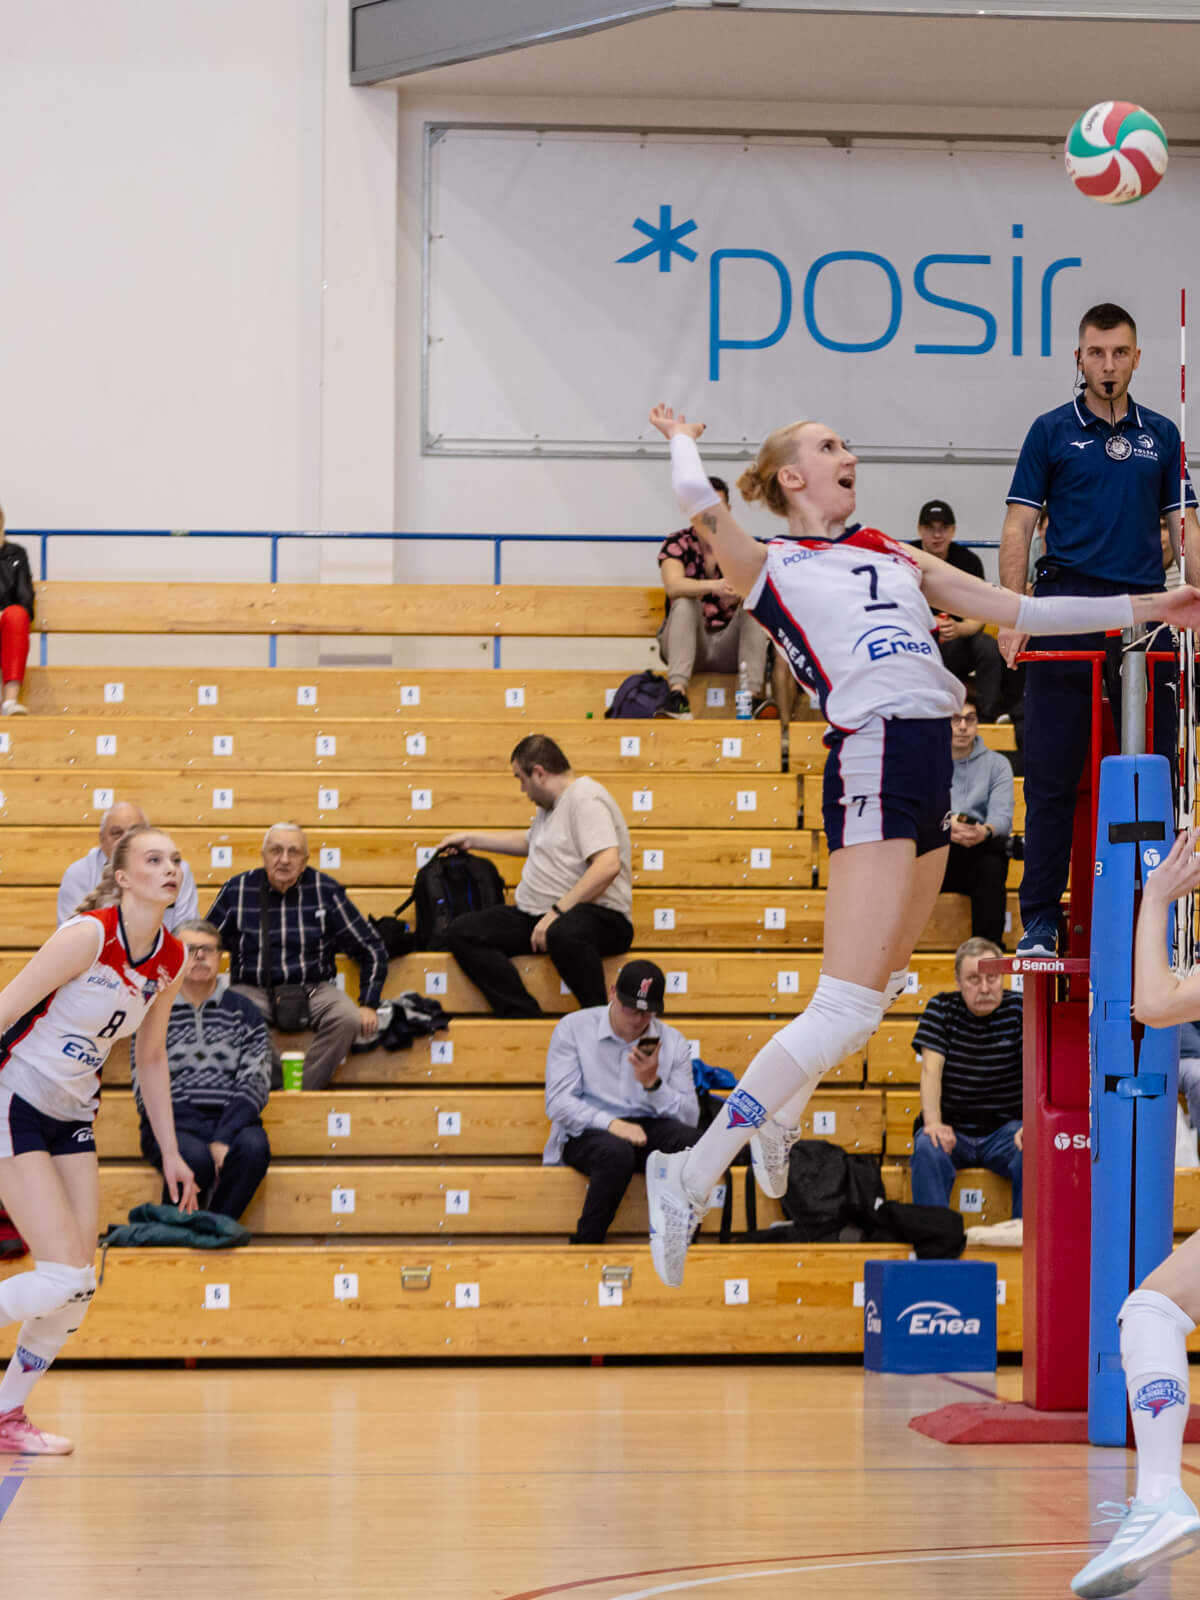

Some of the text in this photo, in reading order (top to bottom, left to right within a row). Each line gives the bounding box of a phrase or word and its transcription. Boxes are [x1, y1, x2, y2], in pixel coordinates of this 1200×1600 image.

[708, 223, 1083, 382] posir
[352, 439, 379, 482] B
[850, 564, 878, 601] 7
[866, 637, 932, 661] Enea
[204, 688, 211, 699] 6
[304, 689, 310, 699] 5
[407, 688, 413, 698] 4
[512, 691, 518, 701] 3
[323, 739, 329, 749] 5
[413, 738, 419, 748] 4
[627, 739, 633, 749] 2
[729, 741, 734, 751] 1
[101, 792, 107, 801] 7
[219, 791, 226, 802] 6
[325, 791, 332, 803] 5
[418, 792, 425, 802] 4
[639, 794, 646, 804] 2
[744, 794, 749, 805] 1
[852, 795, 868, 818] 7
[218, 849, 225, 860] 6
[327, 851, 334, 862] 5
[423, 850, 430, 860] 4
[650, 853, 657, 863] 2
[758, 851, 763, 862] 1
[661, 911, 668, 923] 2
[773, 911, 777, 922] 1
[433, 975, 440, 987] 4
[673, 976, 680, 986] 2
[786, 975, 791, 986] 1
[97, 1010, 127, 1038] 8
[439, 1044, 445, 1056] 4
[335, 1117, 343, 1129] 5
[446, 1116, 453, 1127] 4
[822, 1116, 827, 1127] 1
[339, 1193, 347, 1205] 5
[454, 1193, 461, 1206] 4
[965, 1193, 977, 1204] 16
[342, 1278, 350, 1290] 5
[733, 1284, 740, 1295] 2
[214, 1288, 221, 1300] 6
[464, 1287, 471, 1299] 4
[909, 1313, 981, 1336] Enea
